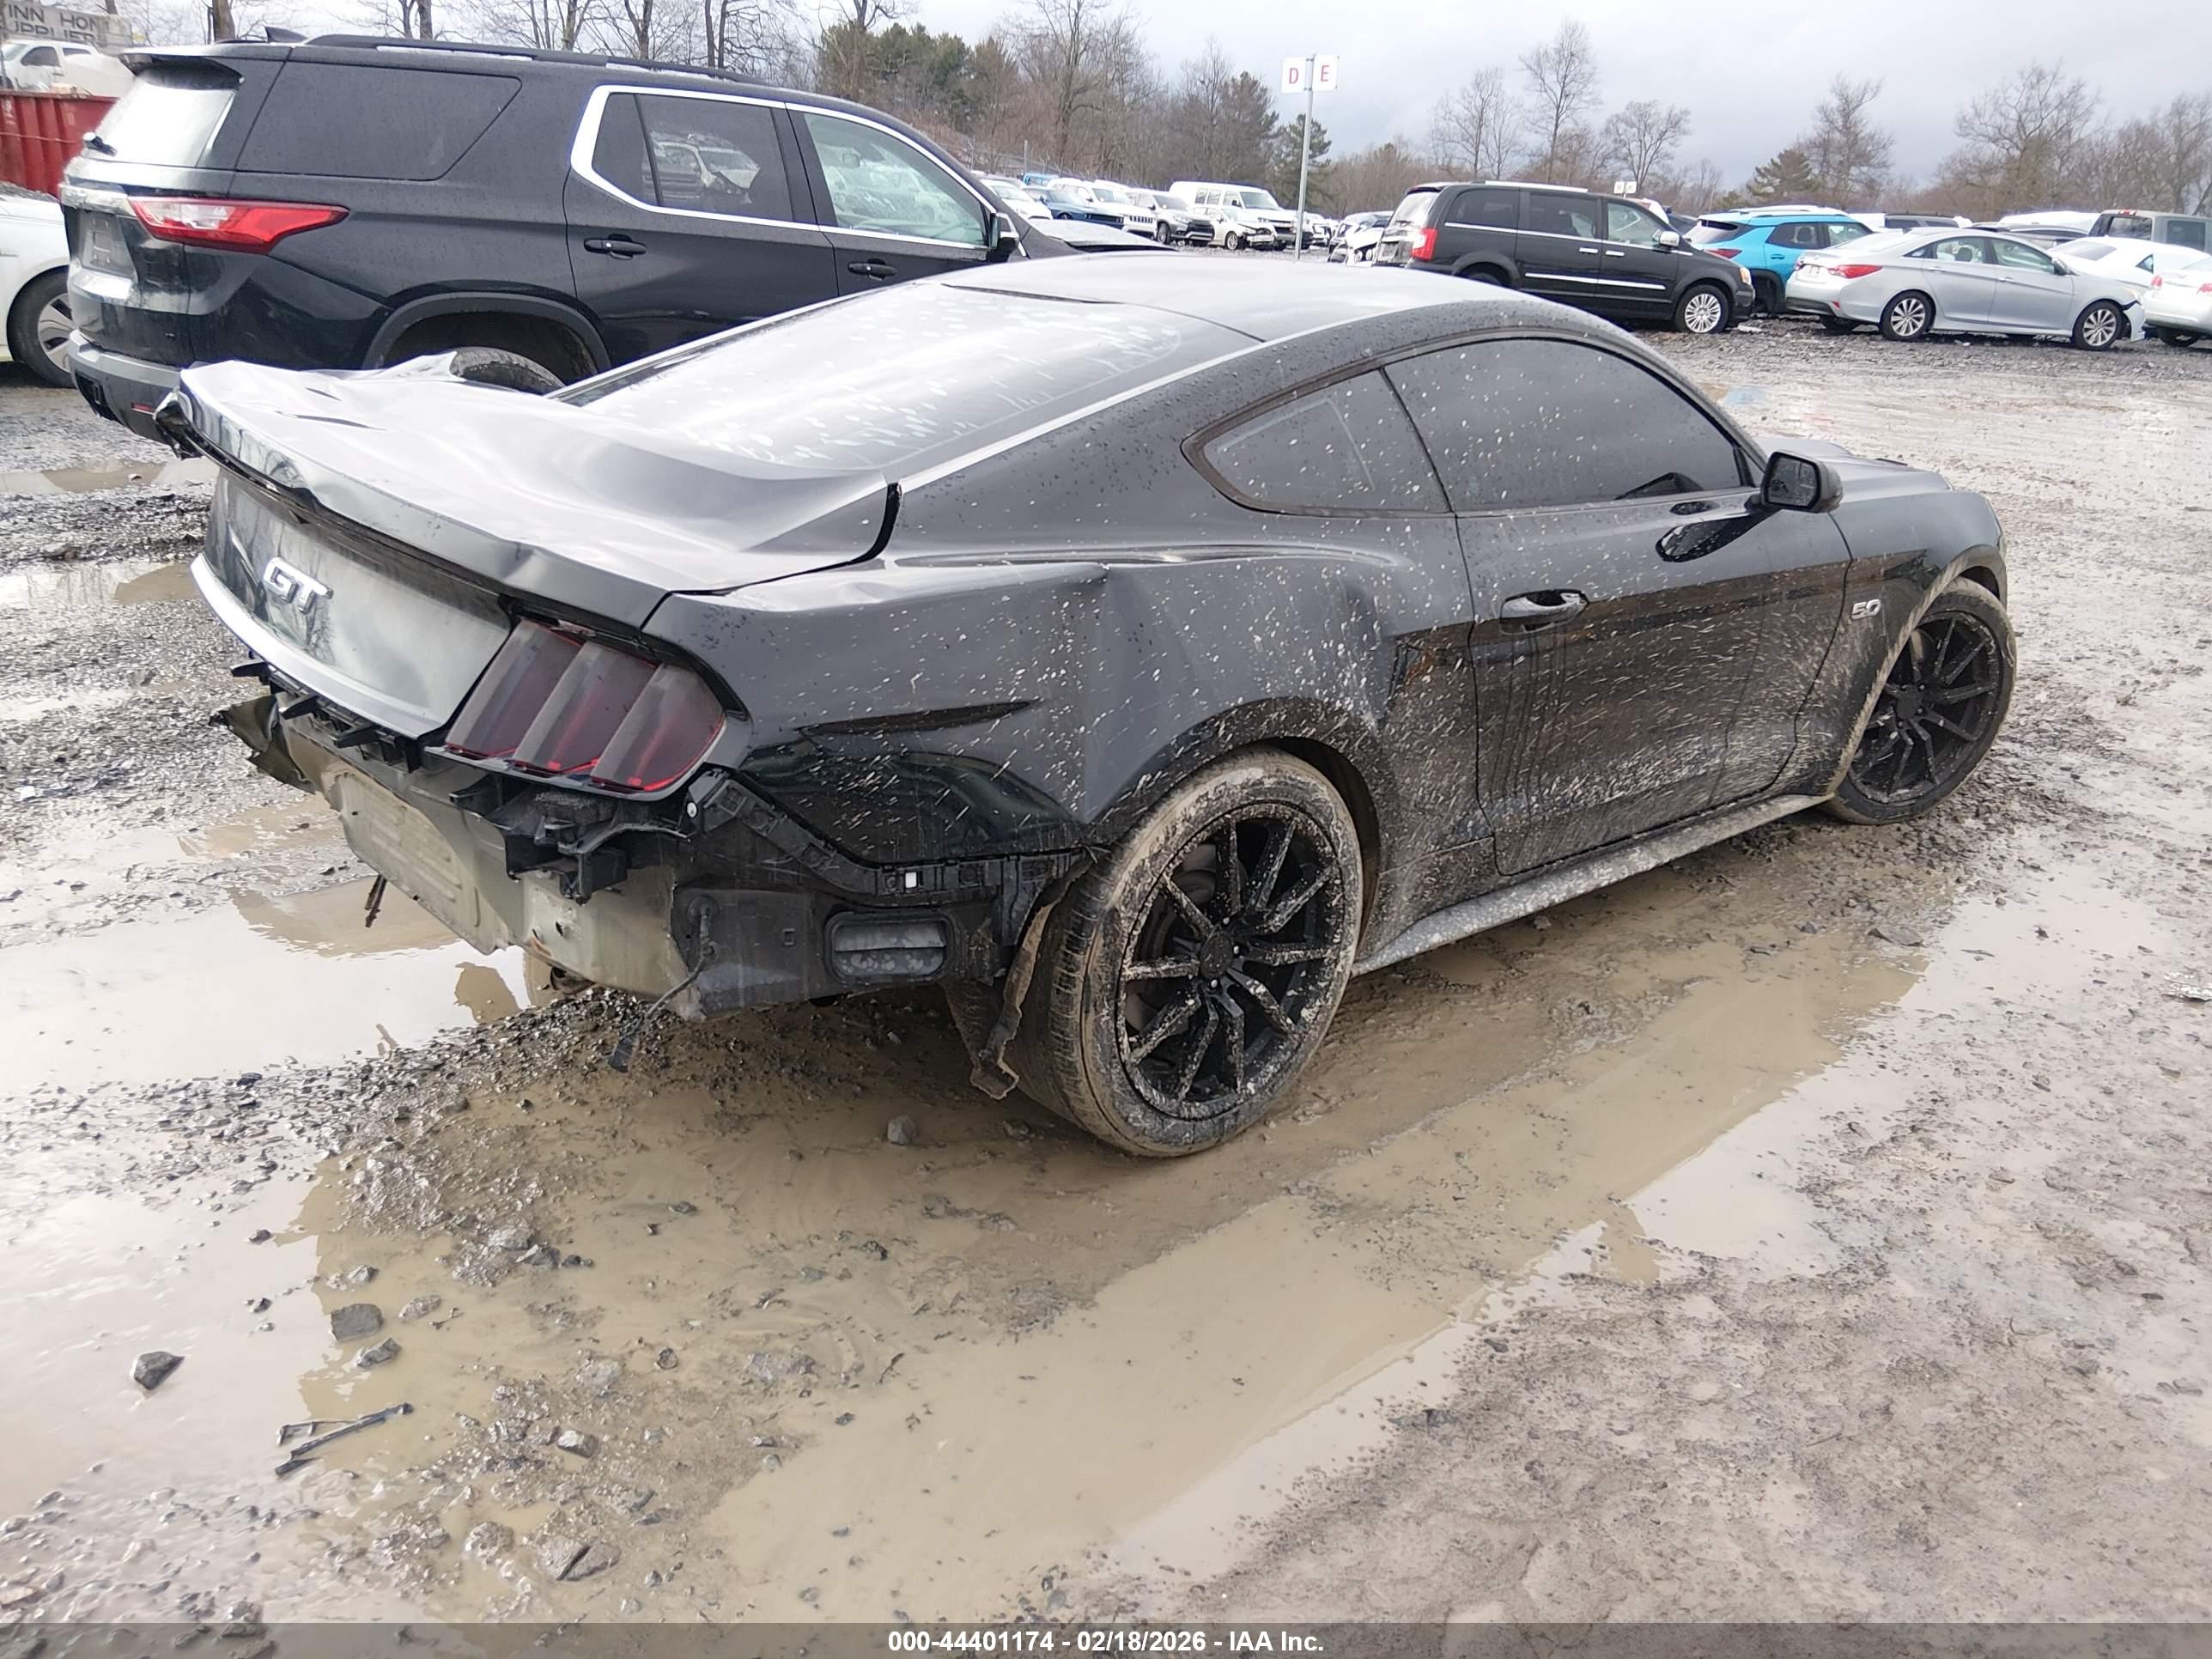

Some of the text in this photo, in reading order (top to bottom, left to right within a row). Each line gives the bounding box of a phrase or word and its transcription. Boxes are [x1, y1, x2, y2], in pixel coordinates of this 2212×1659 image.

[1288, 67, 1299, 84] D
[1320, 64, 1330, 82] E
[263, 556, 334, 616] GT
